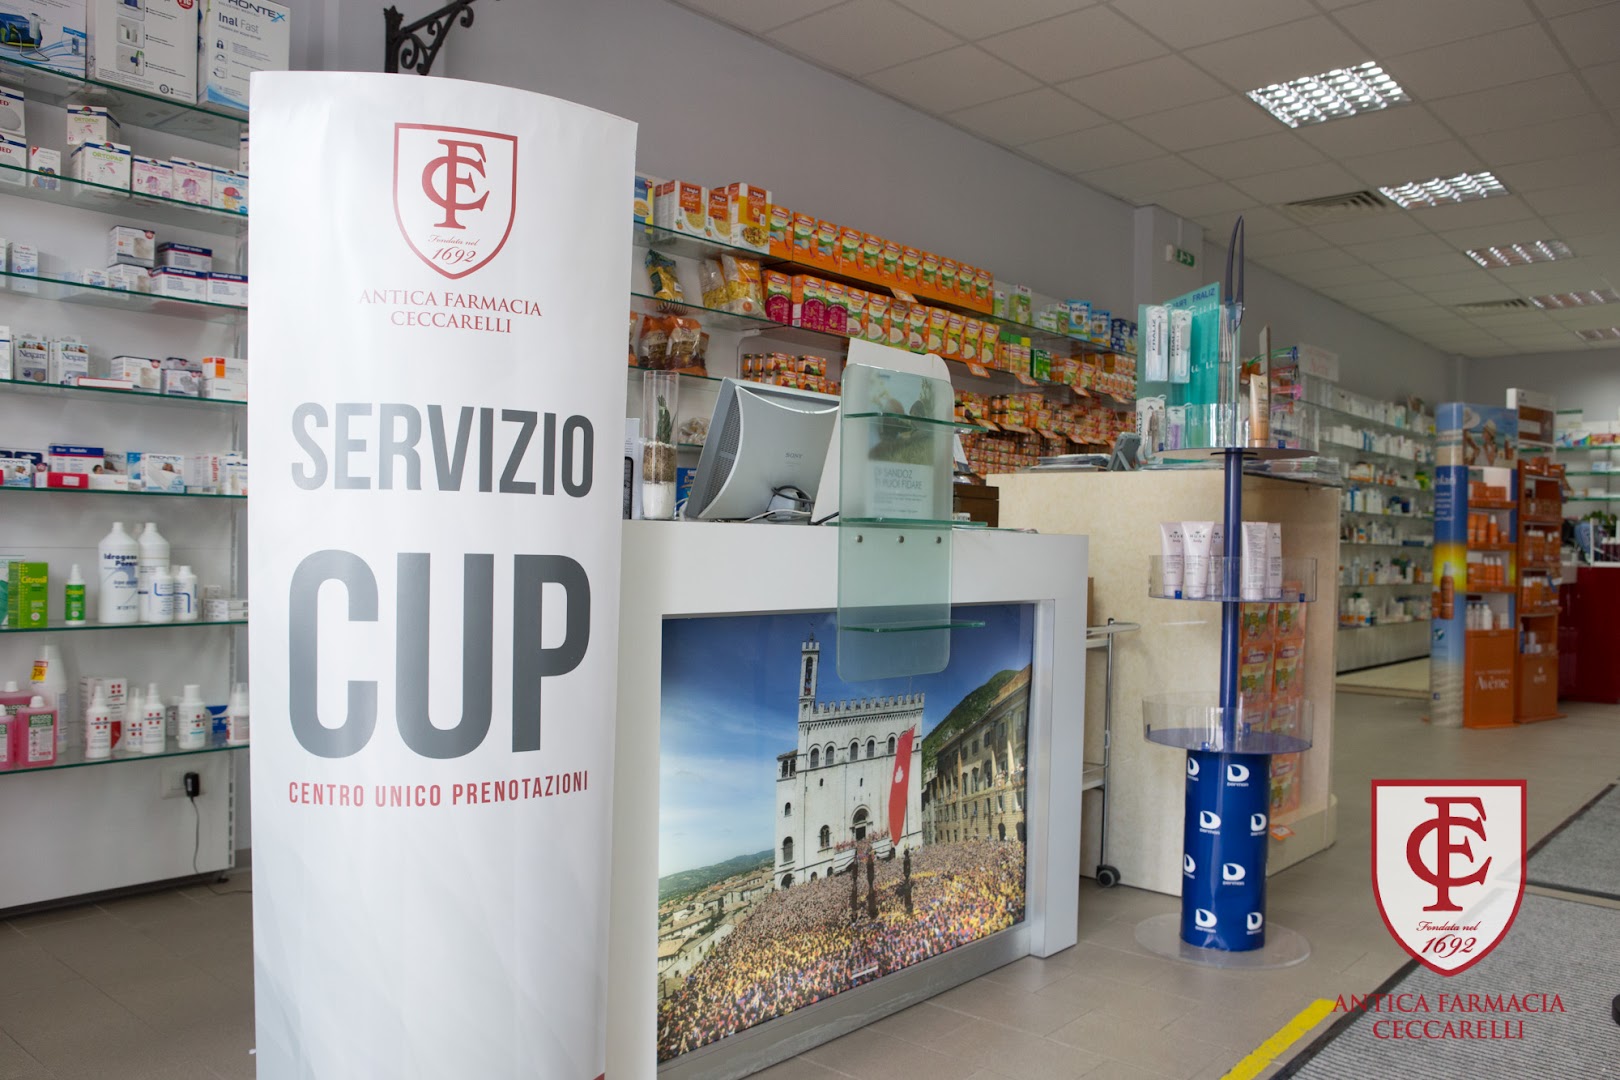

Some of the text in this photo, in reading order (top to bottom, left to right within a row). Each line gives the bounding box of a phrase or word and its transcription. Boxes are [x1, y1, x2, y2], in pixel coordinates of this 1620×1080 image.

[218, 12, 238, 27] Inal
[240, 19, 260, 34] Fast
[92, 151, 124, 162] ORTOPAD
[428, 234, 479, 247] Fondata nel
[432, 246, 476, 265] 1692
[359, 289, 542, 317] ANTICA FARMACIA
[1192, 288, 1215, 302] FRALIZ
[391, 311, 512, 333] CECCARELLI
[19, 349, 46, 360] Nexcare
[62, 352, 87, 362] Nexcare
[291, 402, 594, 498] SERVIZIO
[884, 467, 912, 479] SANDOZ
[902, 480, 922, 490] FIDARE
[289, 549, 591, 760] CUP
[289, 770, 588, 807] CENTRO UNICO PRENOTAZIONI
